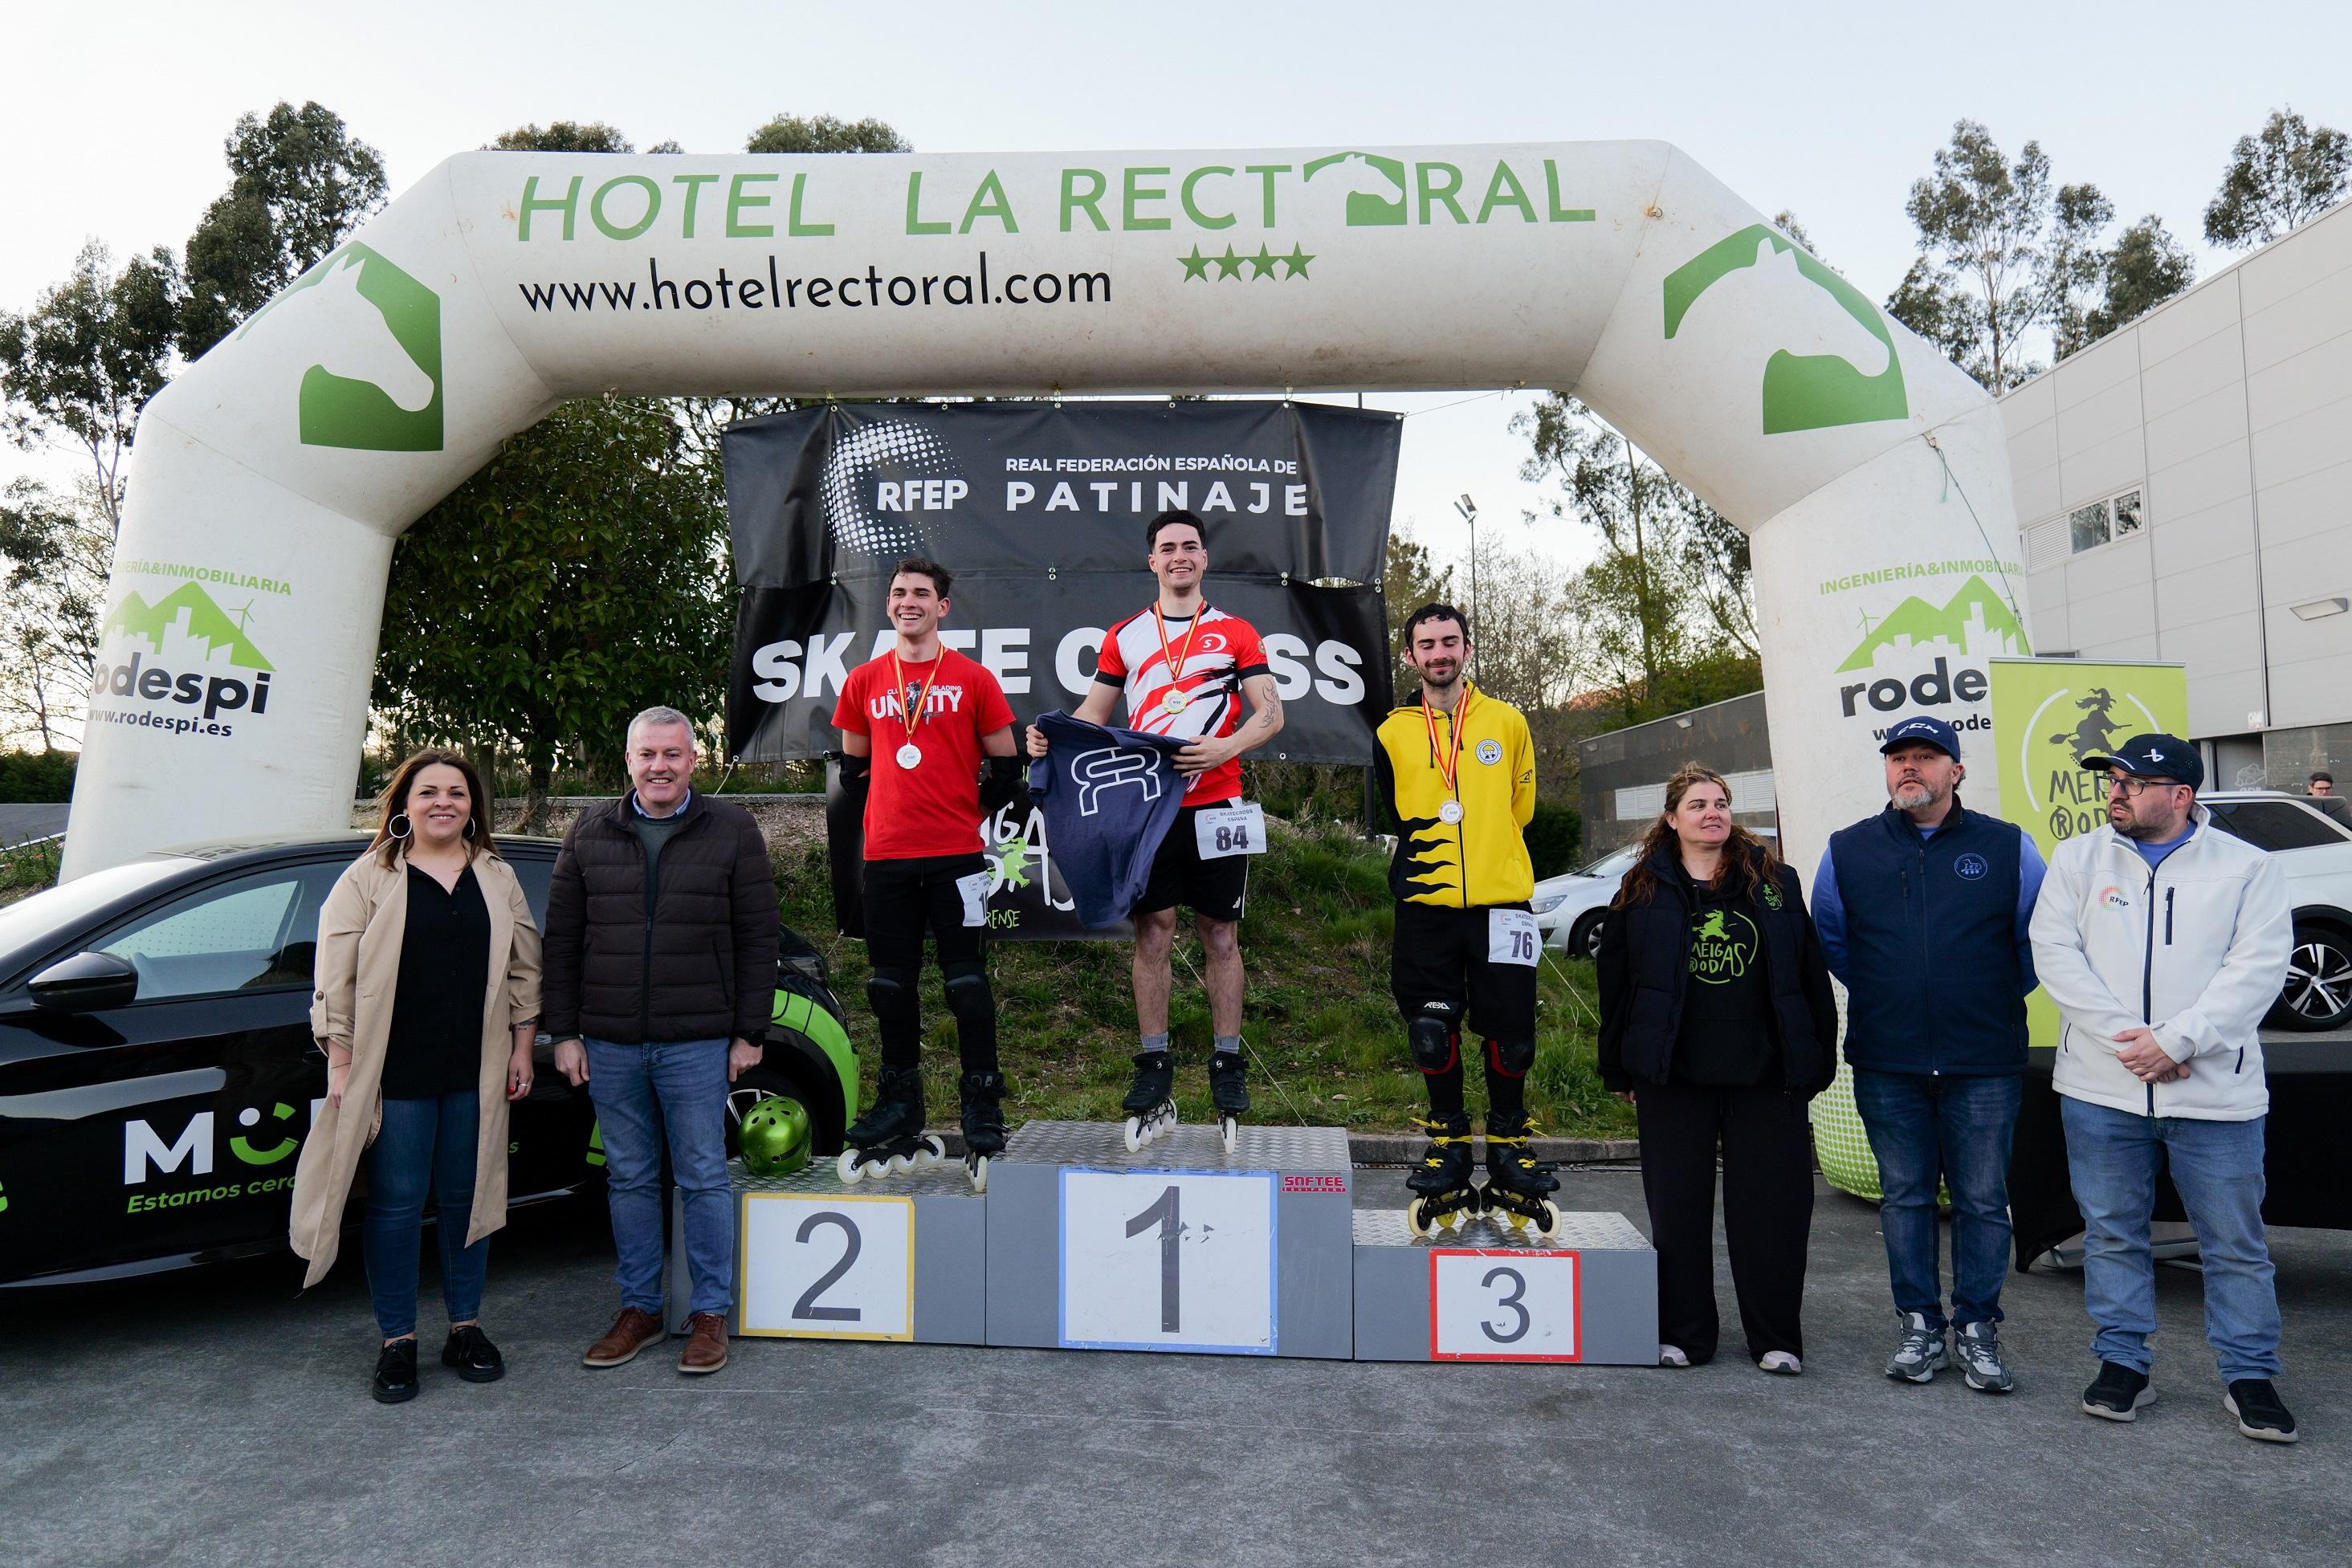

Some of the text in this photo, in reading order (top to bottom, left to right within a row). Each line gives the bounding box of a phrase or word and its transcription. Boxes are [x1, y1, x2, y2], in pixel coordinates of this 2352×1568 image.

[519, 173, 835, 242] HOTEL
[906, 169, 1019, 235] LA
[519, 251, 1111, 313] www.hotelrectoral.com
[1006, 454, 1297, 474] REAL FEDERACIÓN ESPAÑOLA DE
[877, 479, 968, 511] RFEP
[1006, 482, 1308, 515] PATINAJE
[94, 652, 271, 719] odespi
[1055, 627, 1366, 706] CSS
[1840, 658, 1988, 717] rode
[1216, 825, 1249, 852] 84
[2109, 896, 2129, 906] RFEP
[1510, 931, 1533, 959] 76
[127, 1183, 241, 1214] Estamos
[791, 1212, 862, 1322] 2
[1125, 1185, 1181, 1334] 1
[1480, 1266, 1531, 1344] 3
